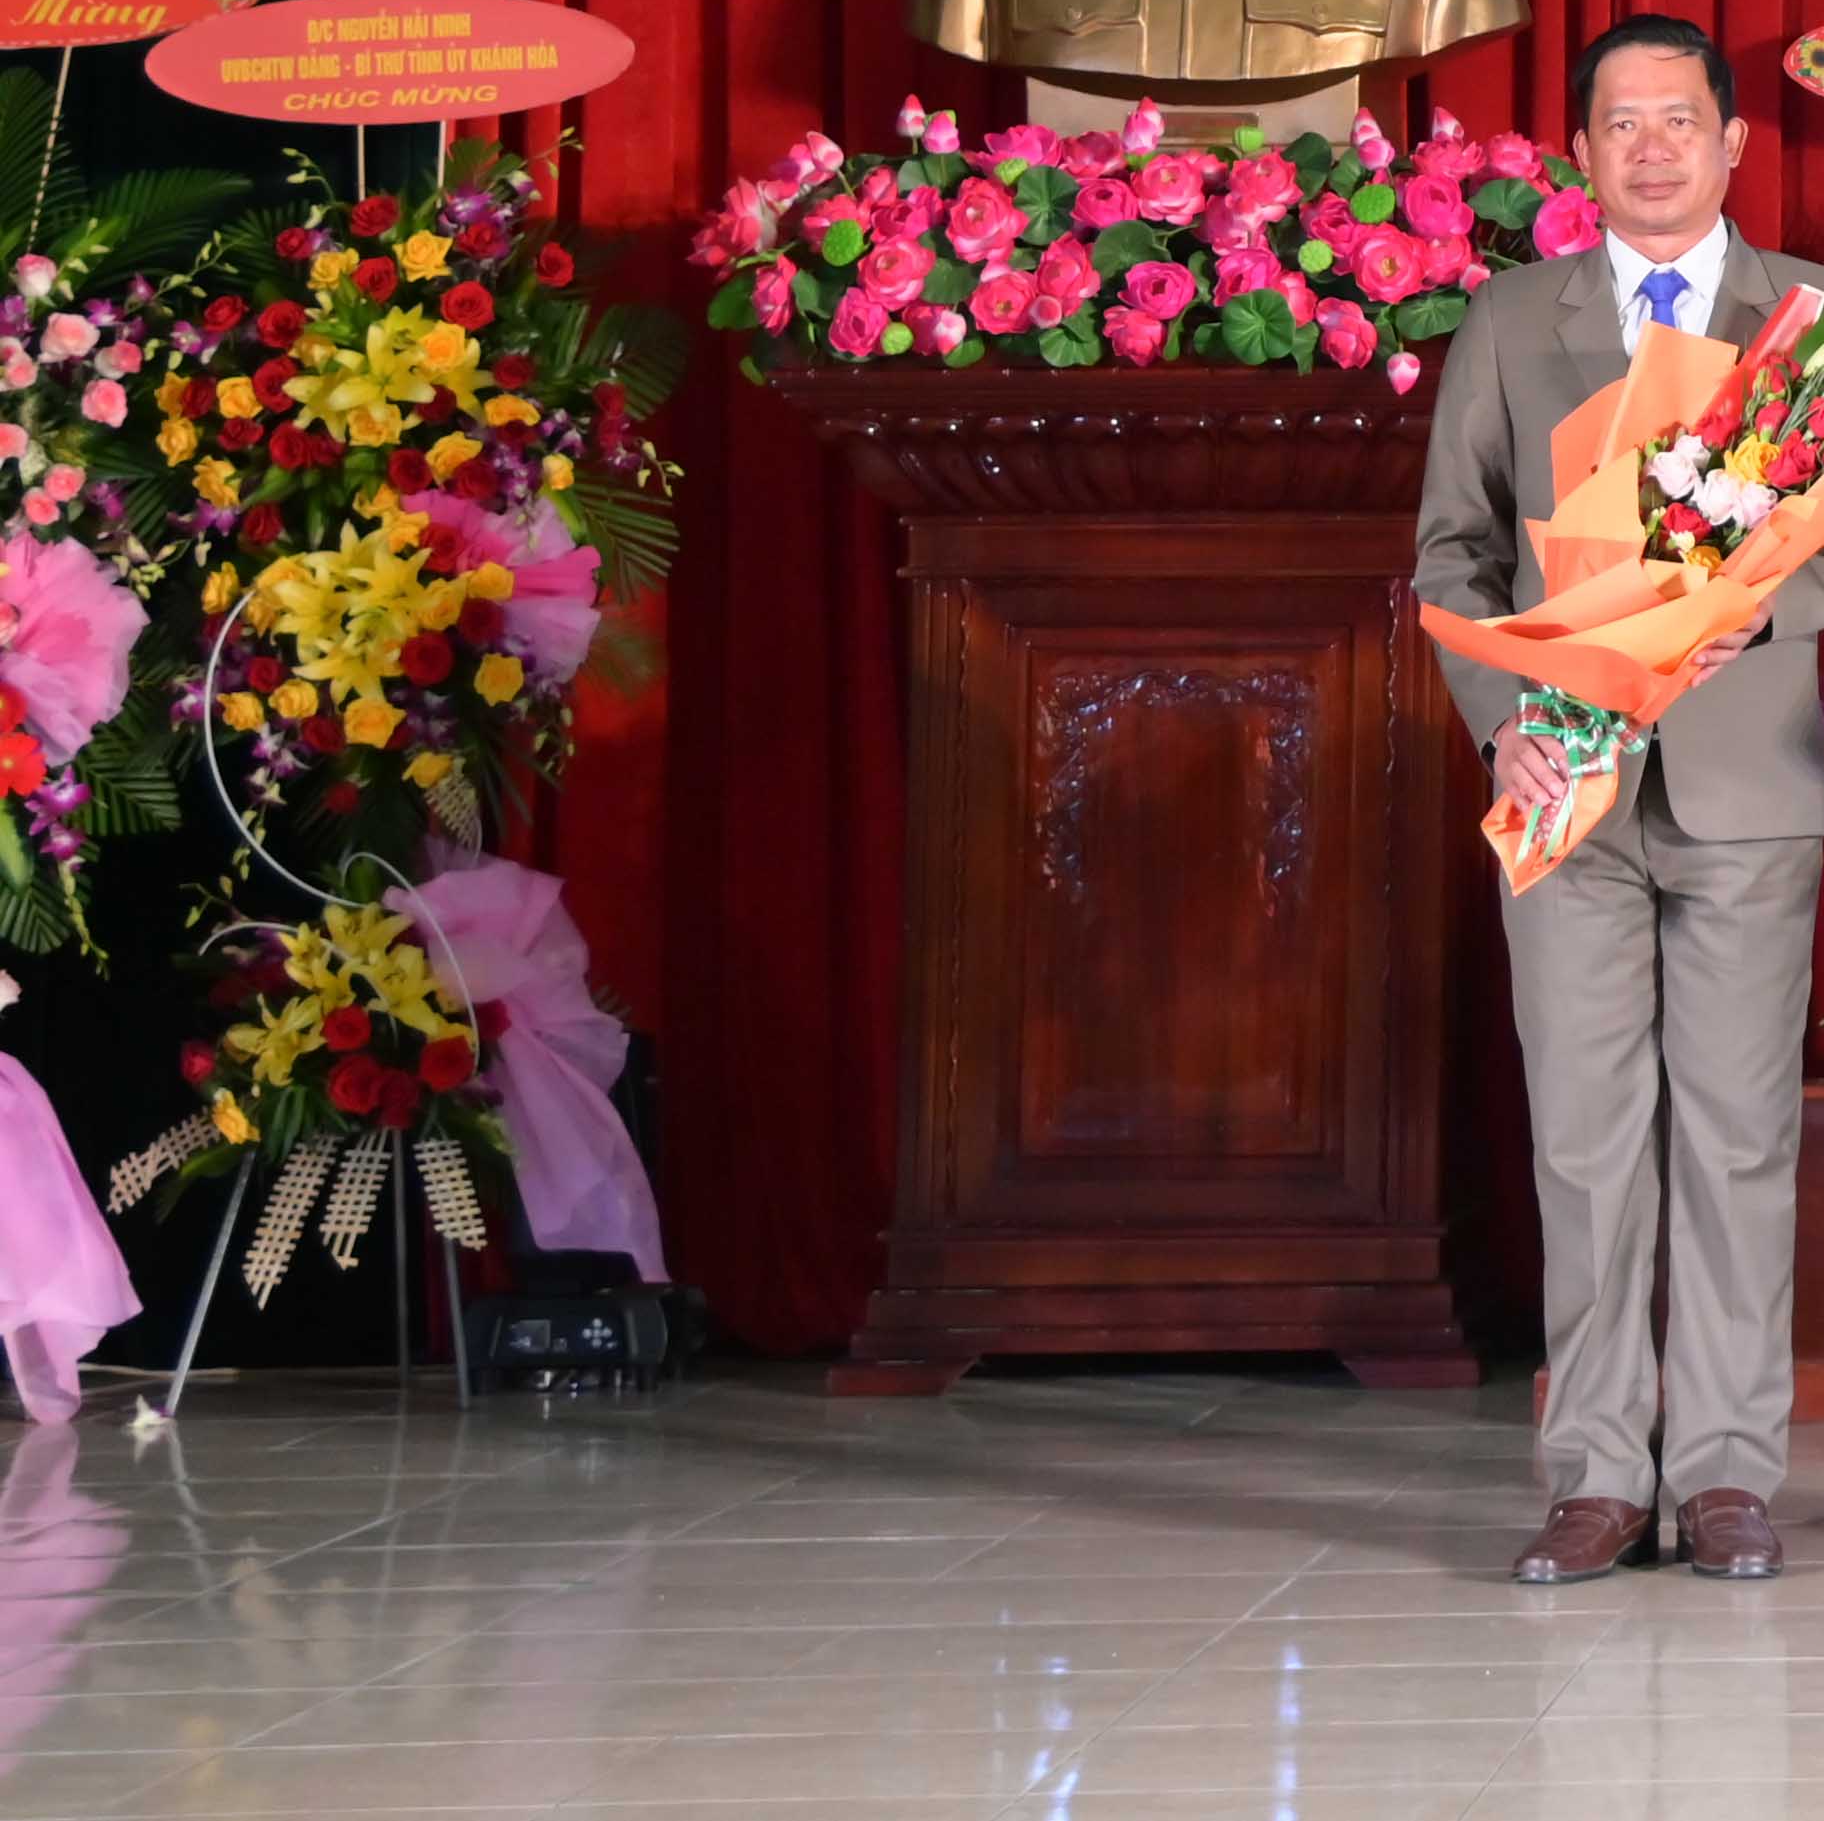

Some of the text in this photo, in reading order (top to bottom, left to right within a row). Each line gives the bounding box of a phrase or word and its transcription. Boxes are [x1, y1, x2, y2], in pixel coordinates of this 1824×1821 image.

[337, 7, 400, 42] NGUYỄN
[402, 7, 430, 40] HẢI
[470, 41, 525, 72] KHÁNH
[526, 38, 560, 69] HÒA
[284, 83, 499, 111] CHÚC MỪNG
